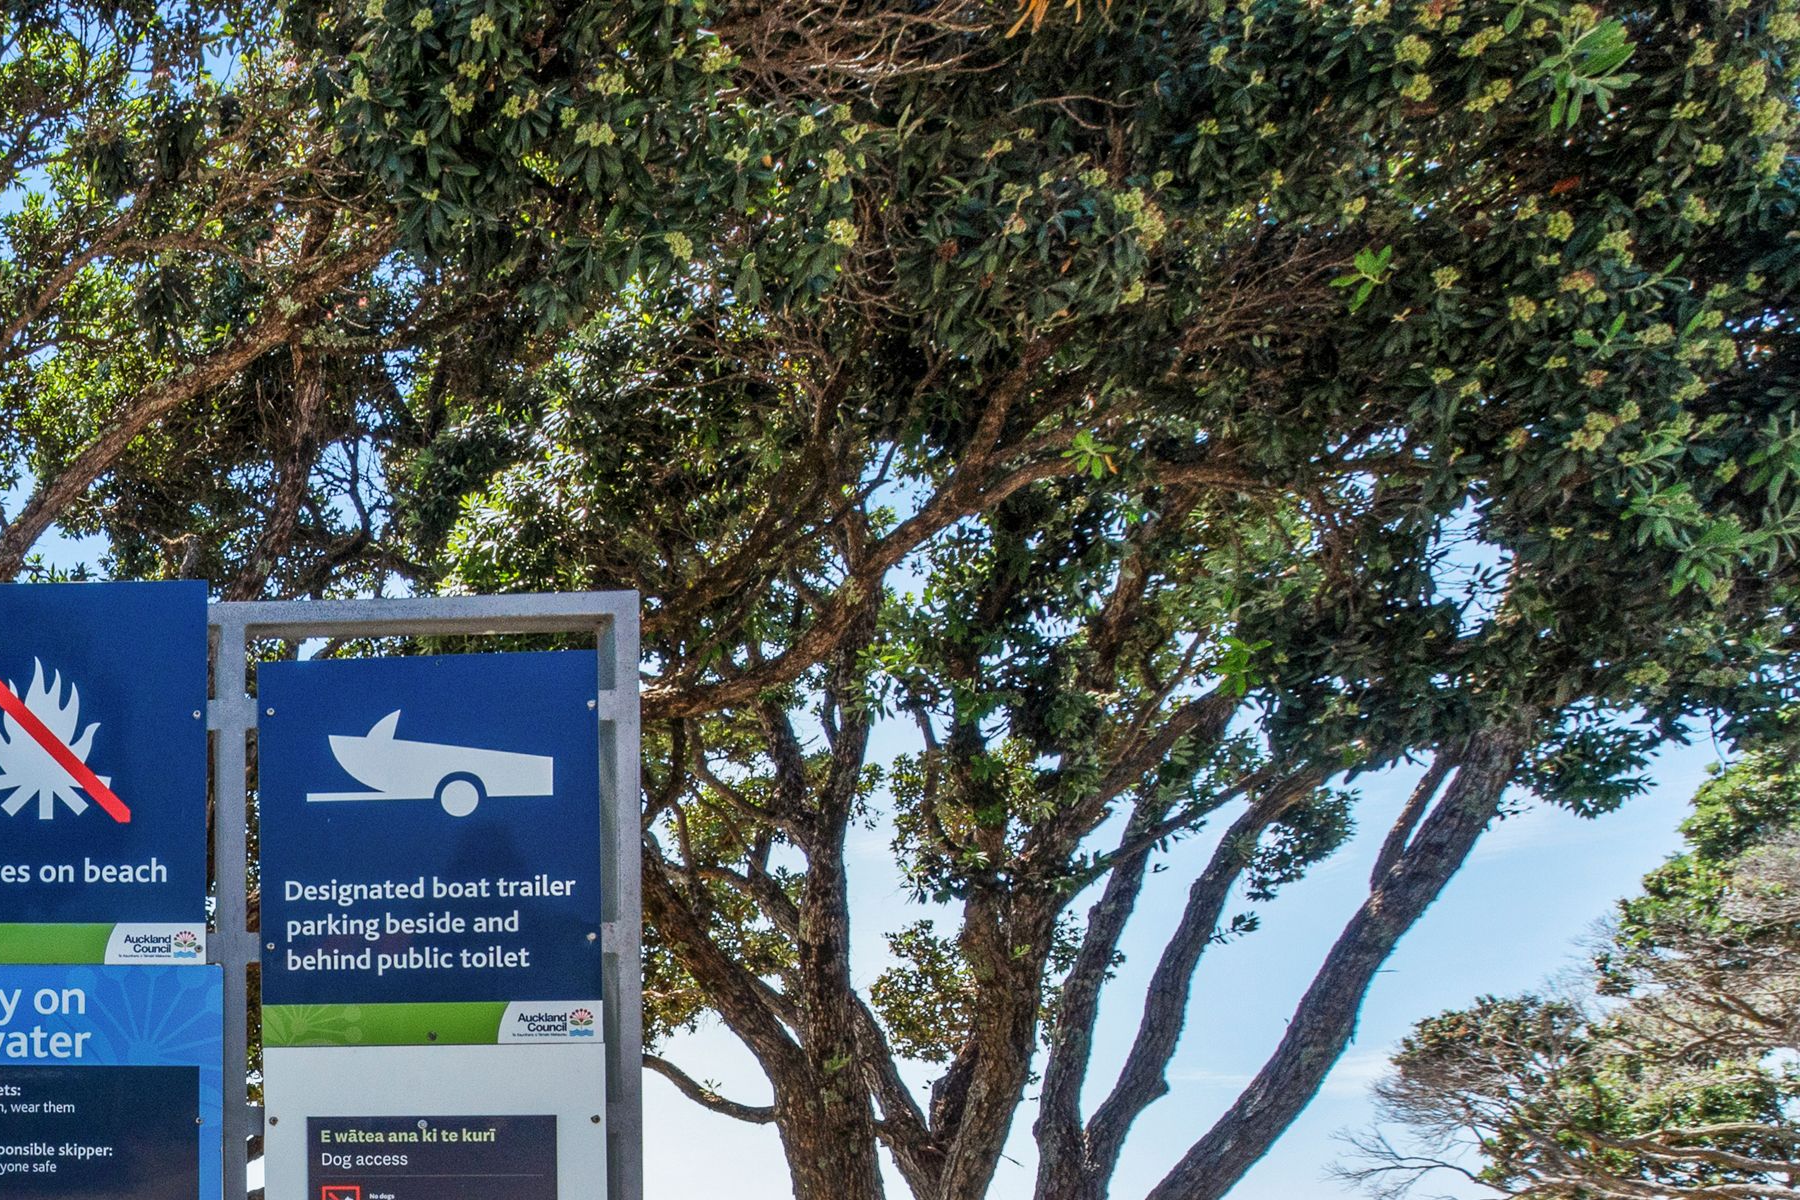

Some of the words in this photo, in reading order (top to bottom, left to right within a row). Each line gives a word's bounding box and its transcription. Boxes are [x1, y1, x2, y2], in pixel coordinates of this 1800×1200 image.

[39, 865, 74, 883] on
[85, 858, 167, 883] beach
[285, 877, 424, 907] Designated
[433, 875, 490, 898] boat
[497, 874, 576, 897] trailer
[287, 913, 380, 943] parking
[386, 911, 465, 935] beside
[473, 910, 519, 933] and
[124, 934, 171, 943] Auckland
[133, 944, 171, 953] Council
[288, 948, 371, 971] behind
[378, 947, 453, 976] public
[460, 945, 530, 968] toilet
[33, 987, 86, 1014] on
[518, 1013, 567, 1022] Auckland
[527, 1023, 567, 1032] Council
[10, 1104, 40, 1113] wear
[43, 1101, 75, 1113] them
[321, 1130, 331, 1142] E
[388, 1132, 419, 1142] ana
[422, 1128, 437, 1142] ki
[441, 1130, 458, 1142] te
[59, 1143, 113, 1159] skipper:
[33, 1160, 57, 1173] safe
[322, 1153, 352, 1169] Dog
[356, 1155, 408, 1166] access
